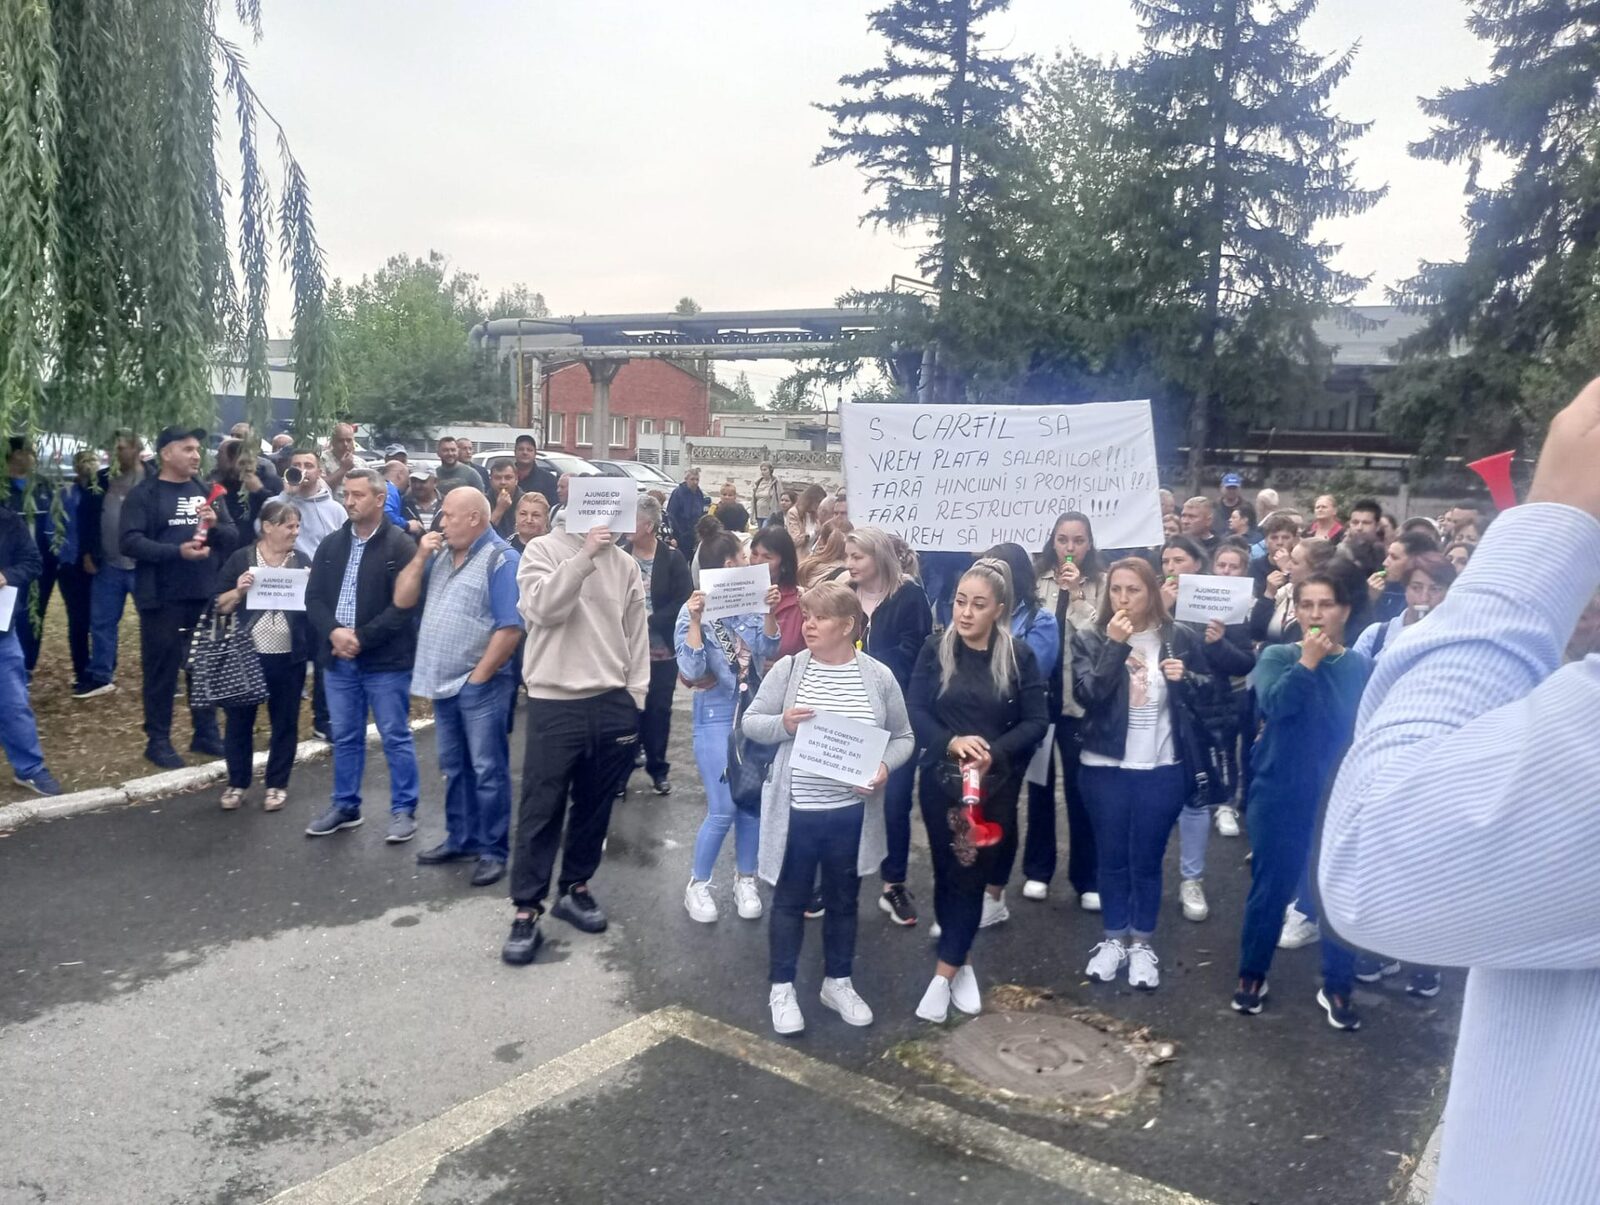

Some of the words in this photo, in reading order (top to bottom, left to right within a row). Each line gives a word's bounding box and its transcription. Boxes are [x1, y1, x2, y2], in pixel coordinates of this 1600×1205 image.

[1038, 414, 1070, 437] SA
[868, 449, 922, 472] VREM
[932, 448, 989, 471] PLATA
